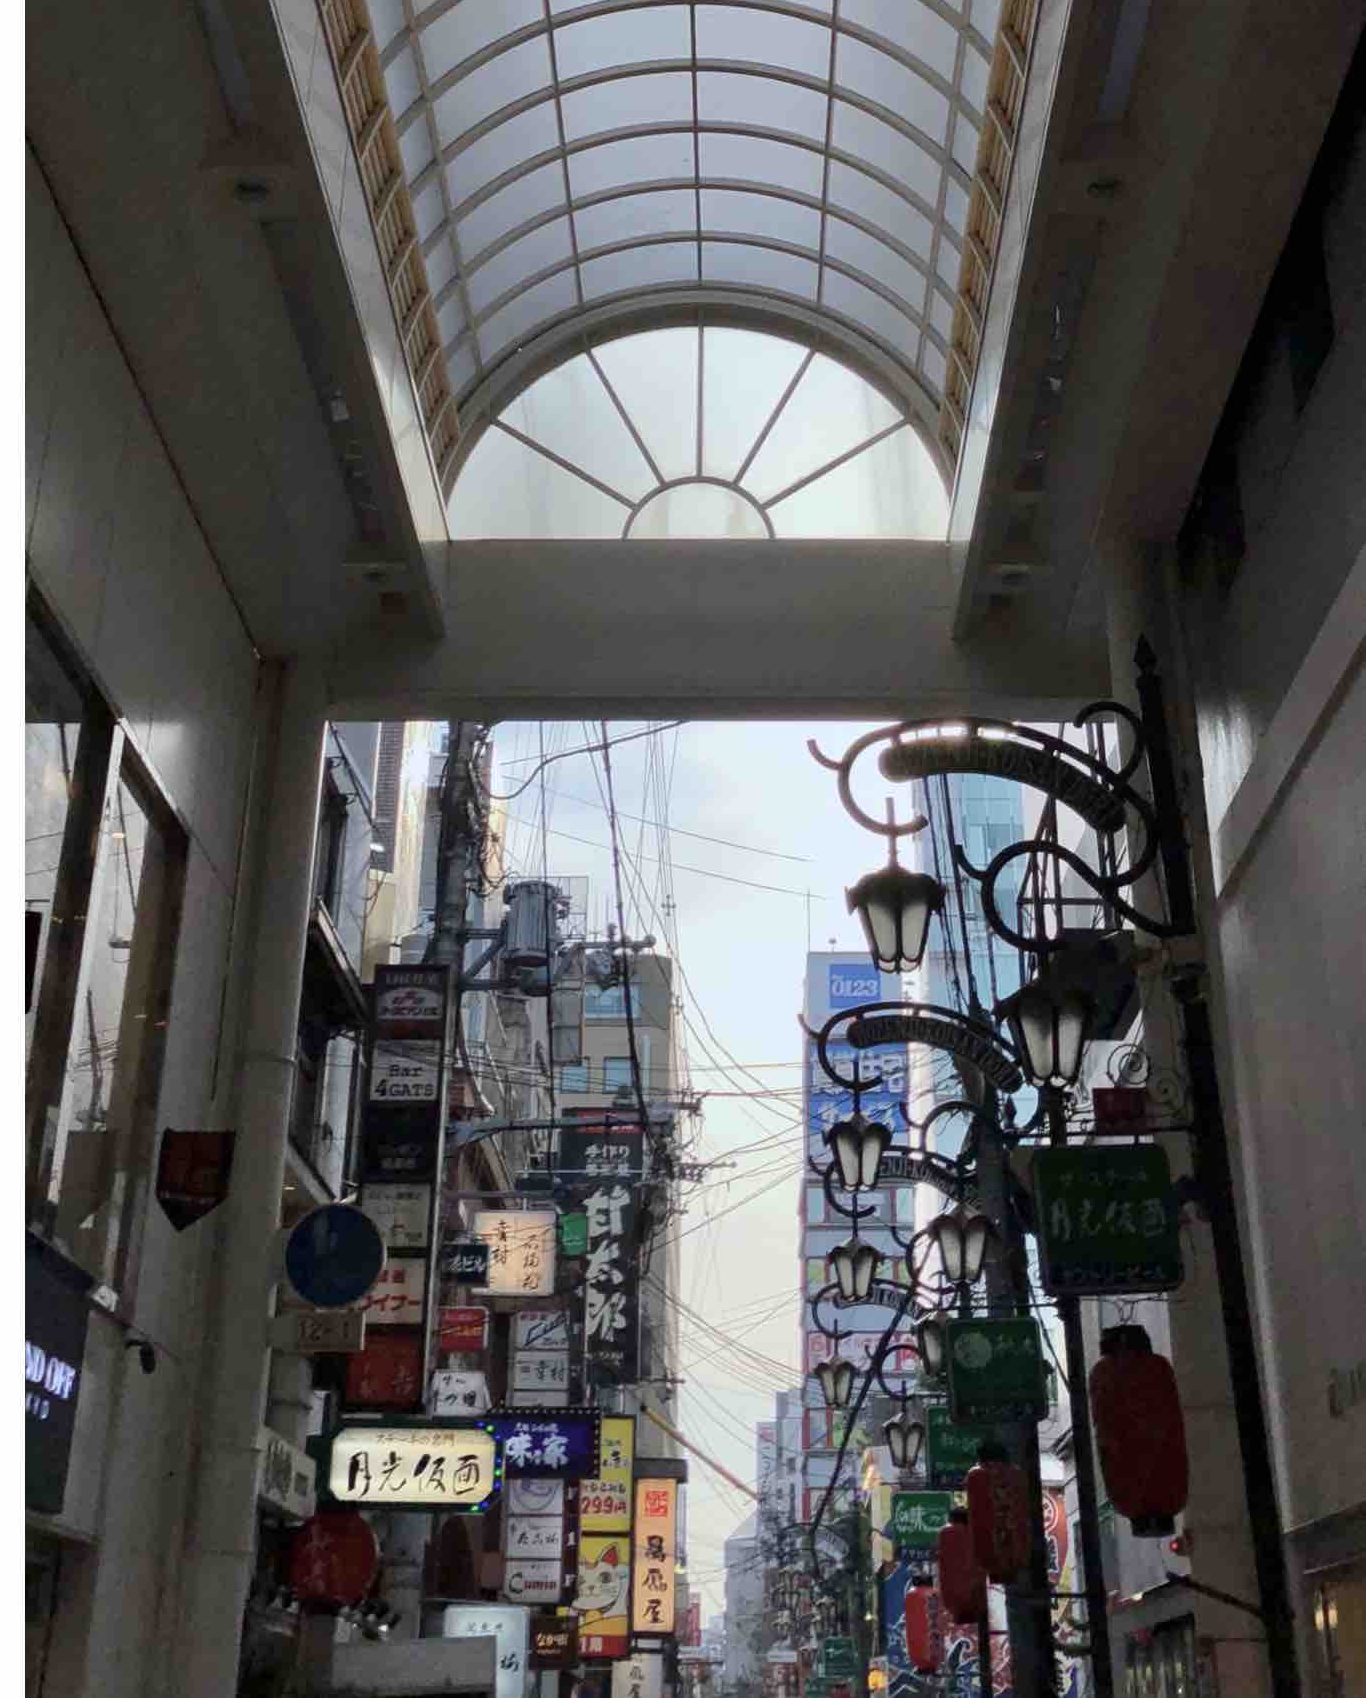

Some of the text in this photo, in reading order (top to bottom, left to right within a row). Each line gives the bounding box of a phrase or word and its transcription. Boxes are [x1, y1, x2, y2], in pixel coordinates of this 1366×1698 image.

[831, 979, 879, 999] 0123
[388, 1063, 422, 1078] Bar
[374, 1078, 435, 1097] 4GATS
[584, 1143, 631, 1159] 手作り
[347, 1451, 480, 1496] 月光仮面
[580, 1495, 627, 1514] 299円
